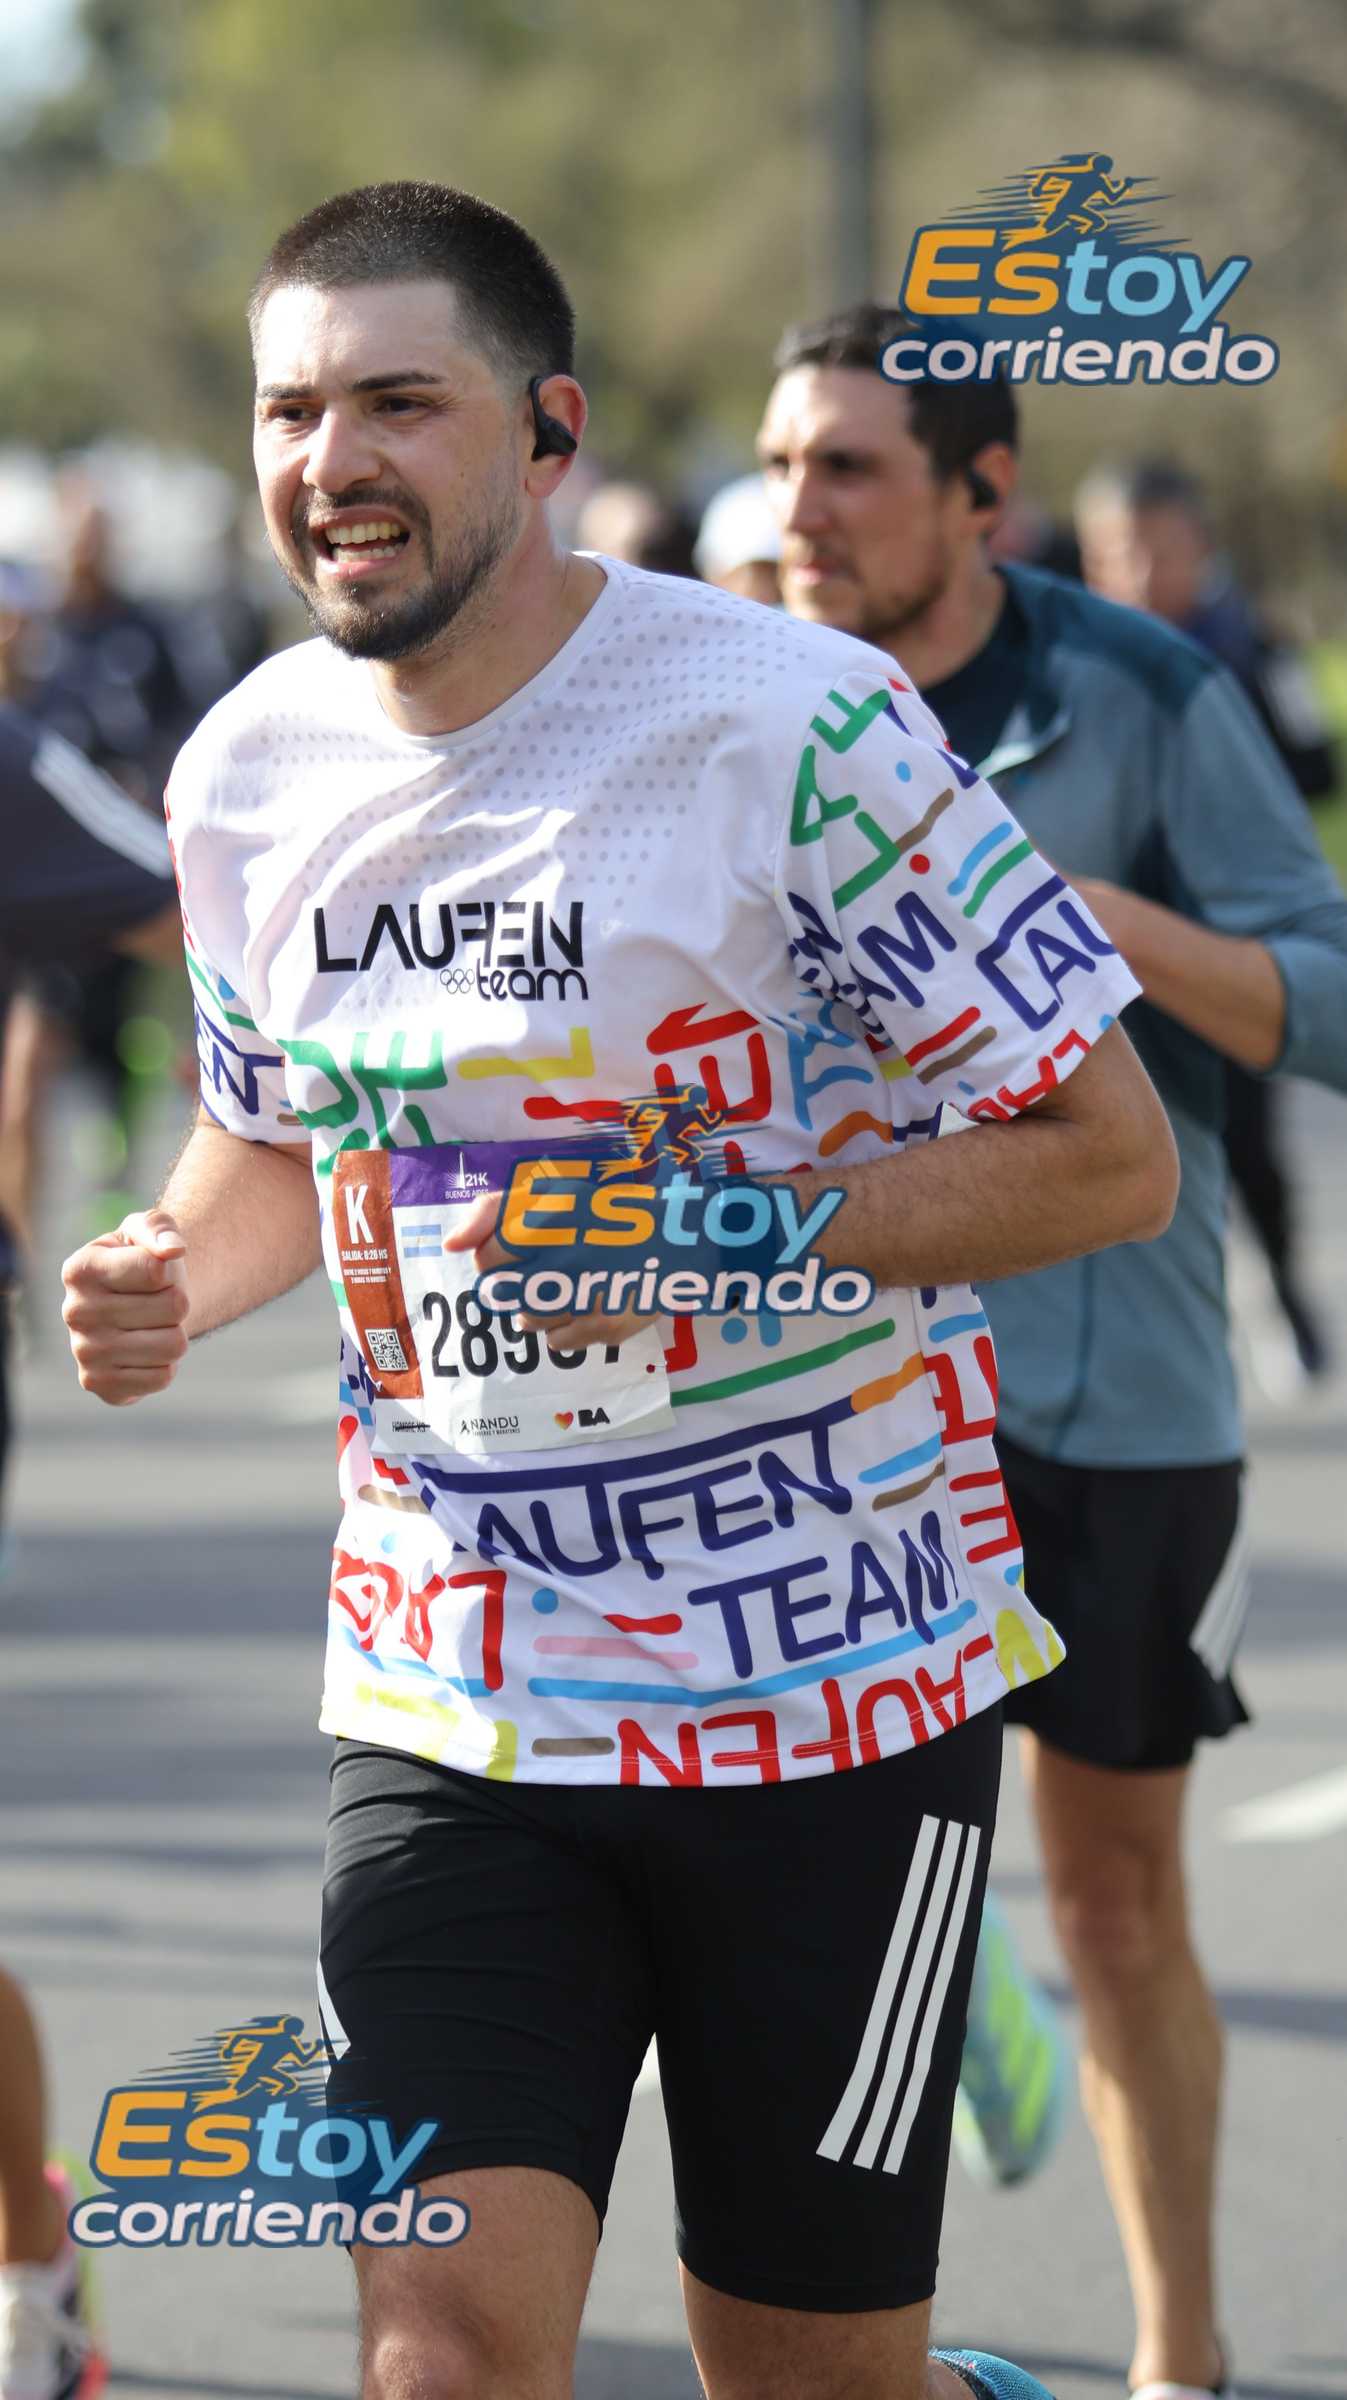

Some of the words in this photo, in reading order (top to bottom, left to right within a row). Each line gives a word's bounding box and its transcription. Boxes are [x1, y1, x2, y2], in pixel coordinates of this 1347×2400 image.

[313, 901, 585, 973] LAUFEN
[475, 956, 589, 1002] team
[444, 1190, 471, 1200] BUENOS
[465, 1172, 489, 1187] 21K
[344, 1184, 375, 1244] K
[422, 1291, 621, 1378] 289
[577, 1407, 611, 1428] BA
[687, 1510, 959, 1680] TEAM
